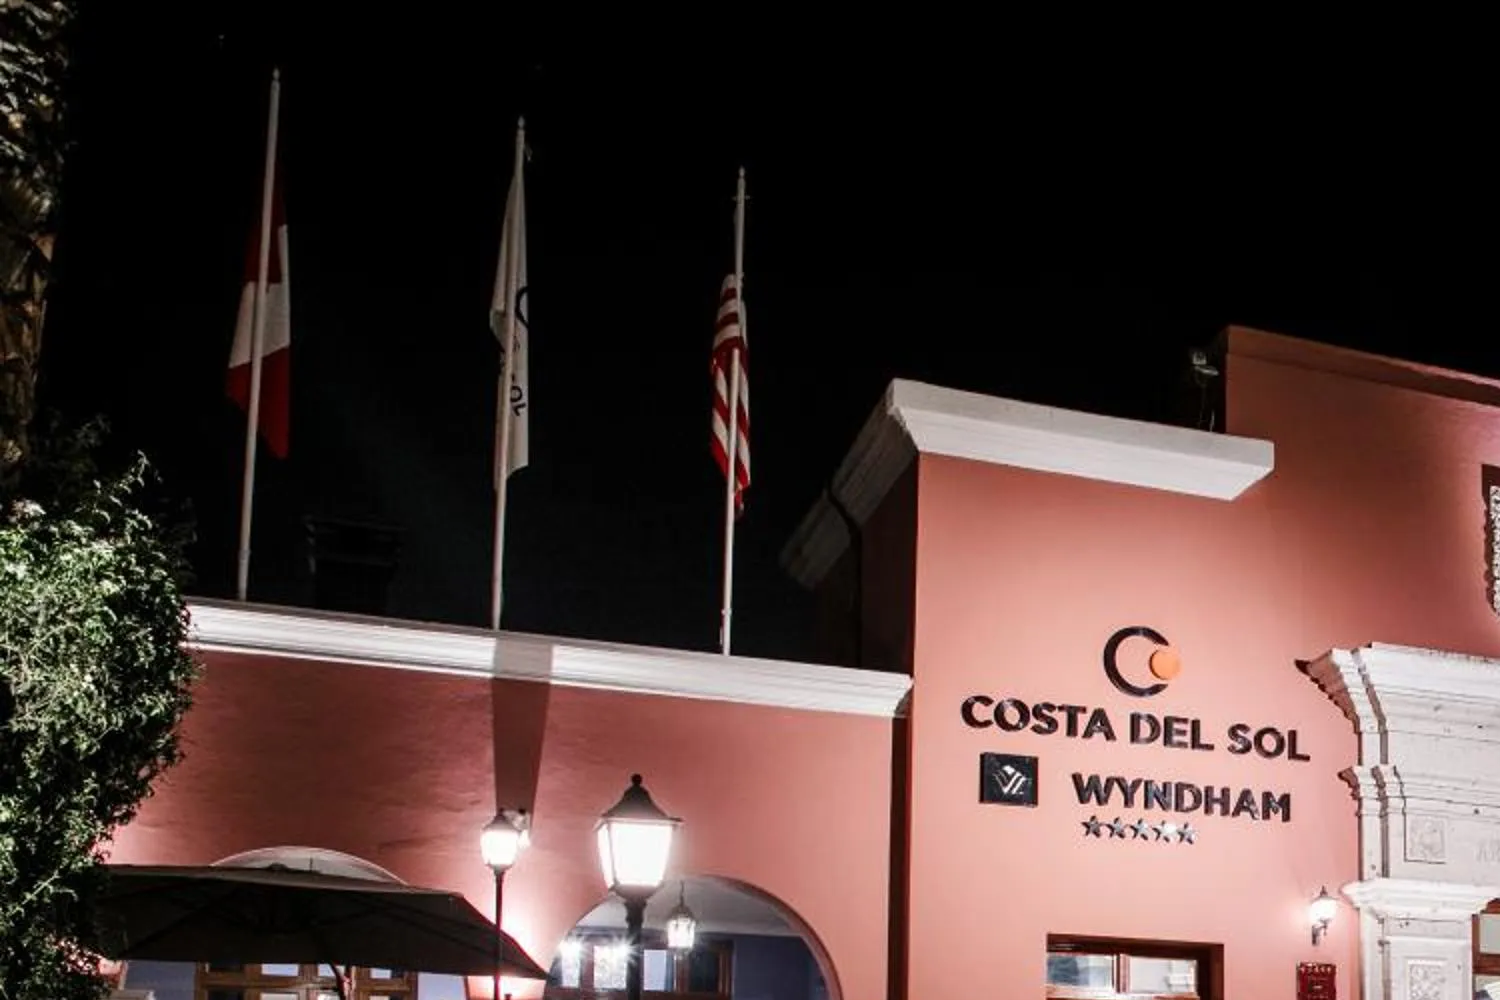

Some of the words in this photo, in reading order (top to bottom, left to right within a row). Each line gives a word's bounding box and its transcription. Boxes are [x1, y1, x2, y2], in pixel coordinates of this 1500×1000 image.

[961, 695, 1116, 741] COSTA
[1130, 713, 1215, 751] DEL
[1228, 724, 1310, 761] SOL
[1072, 773, 1291, 822] WYNDHAM
